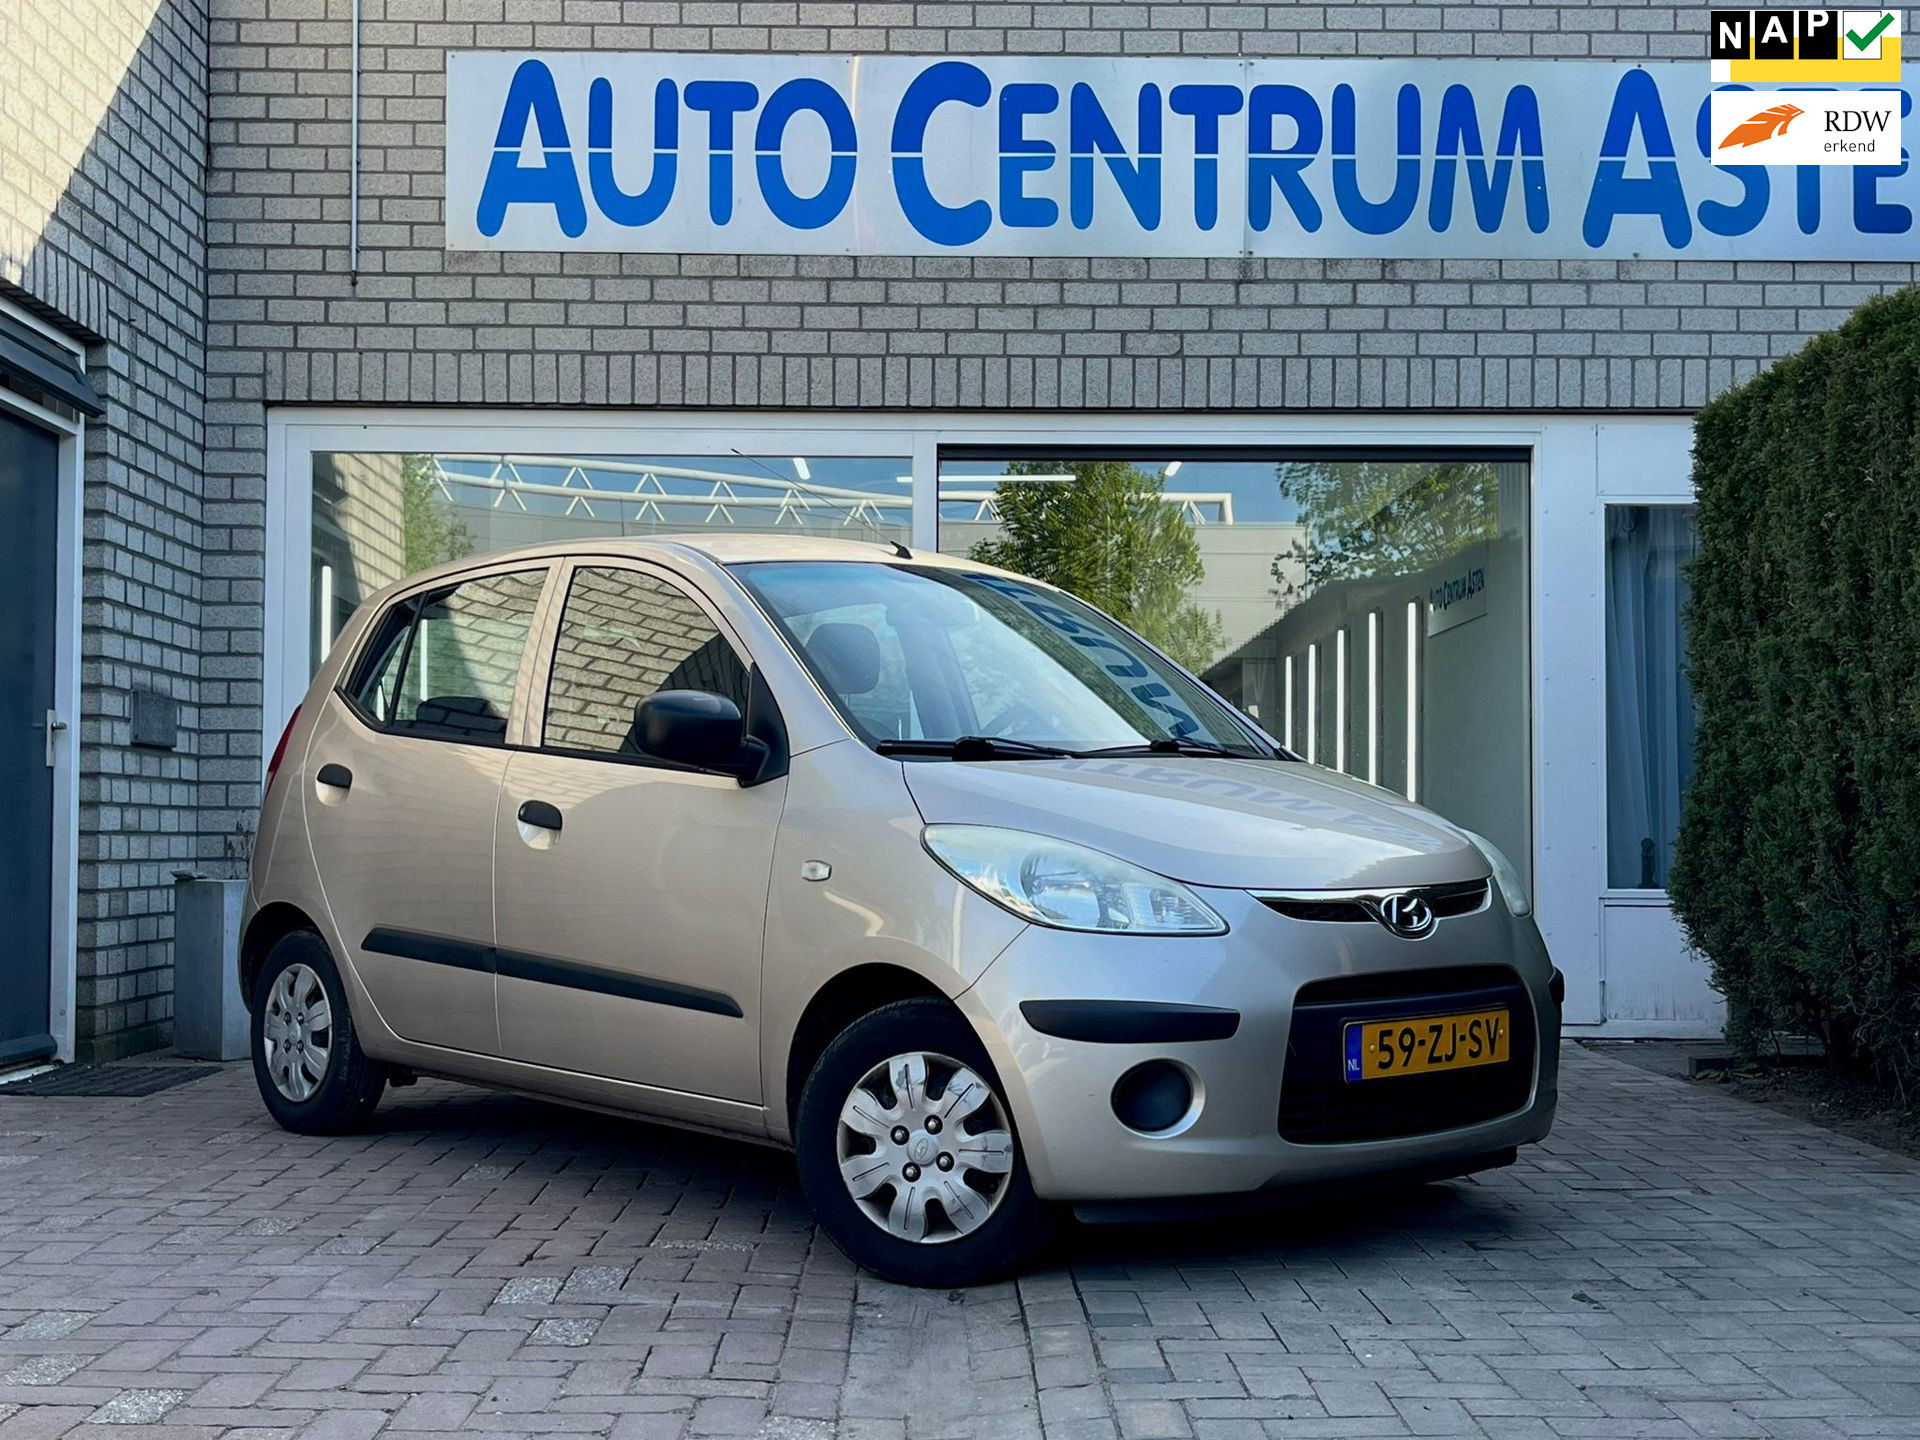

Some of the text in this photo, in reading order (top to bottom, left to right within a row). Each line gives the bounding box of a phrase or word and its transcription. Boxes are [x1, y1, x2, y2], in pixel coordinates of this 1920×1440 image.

[476, 59, 858, 239] AUTO
[891, 61, 1551, 246] CENTRUM
[1347, 1059, 1360, 1071] NL
[1377, 1017, 1499, 1070] 59-ZJ-SV
